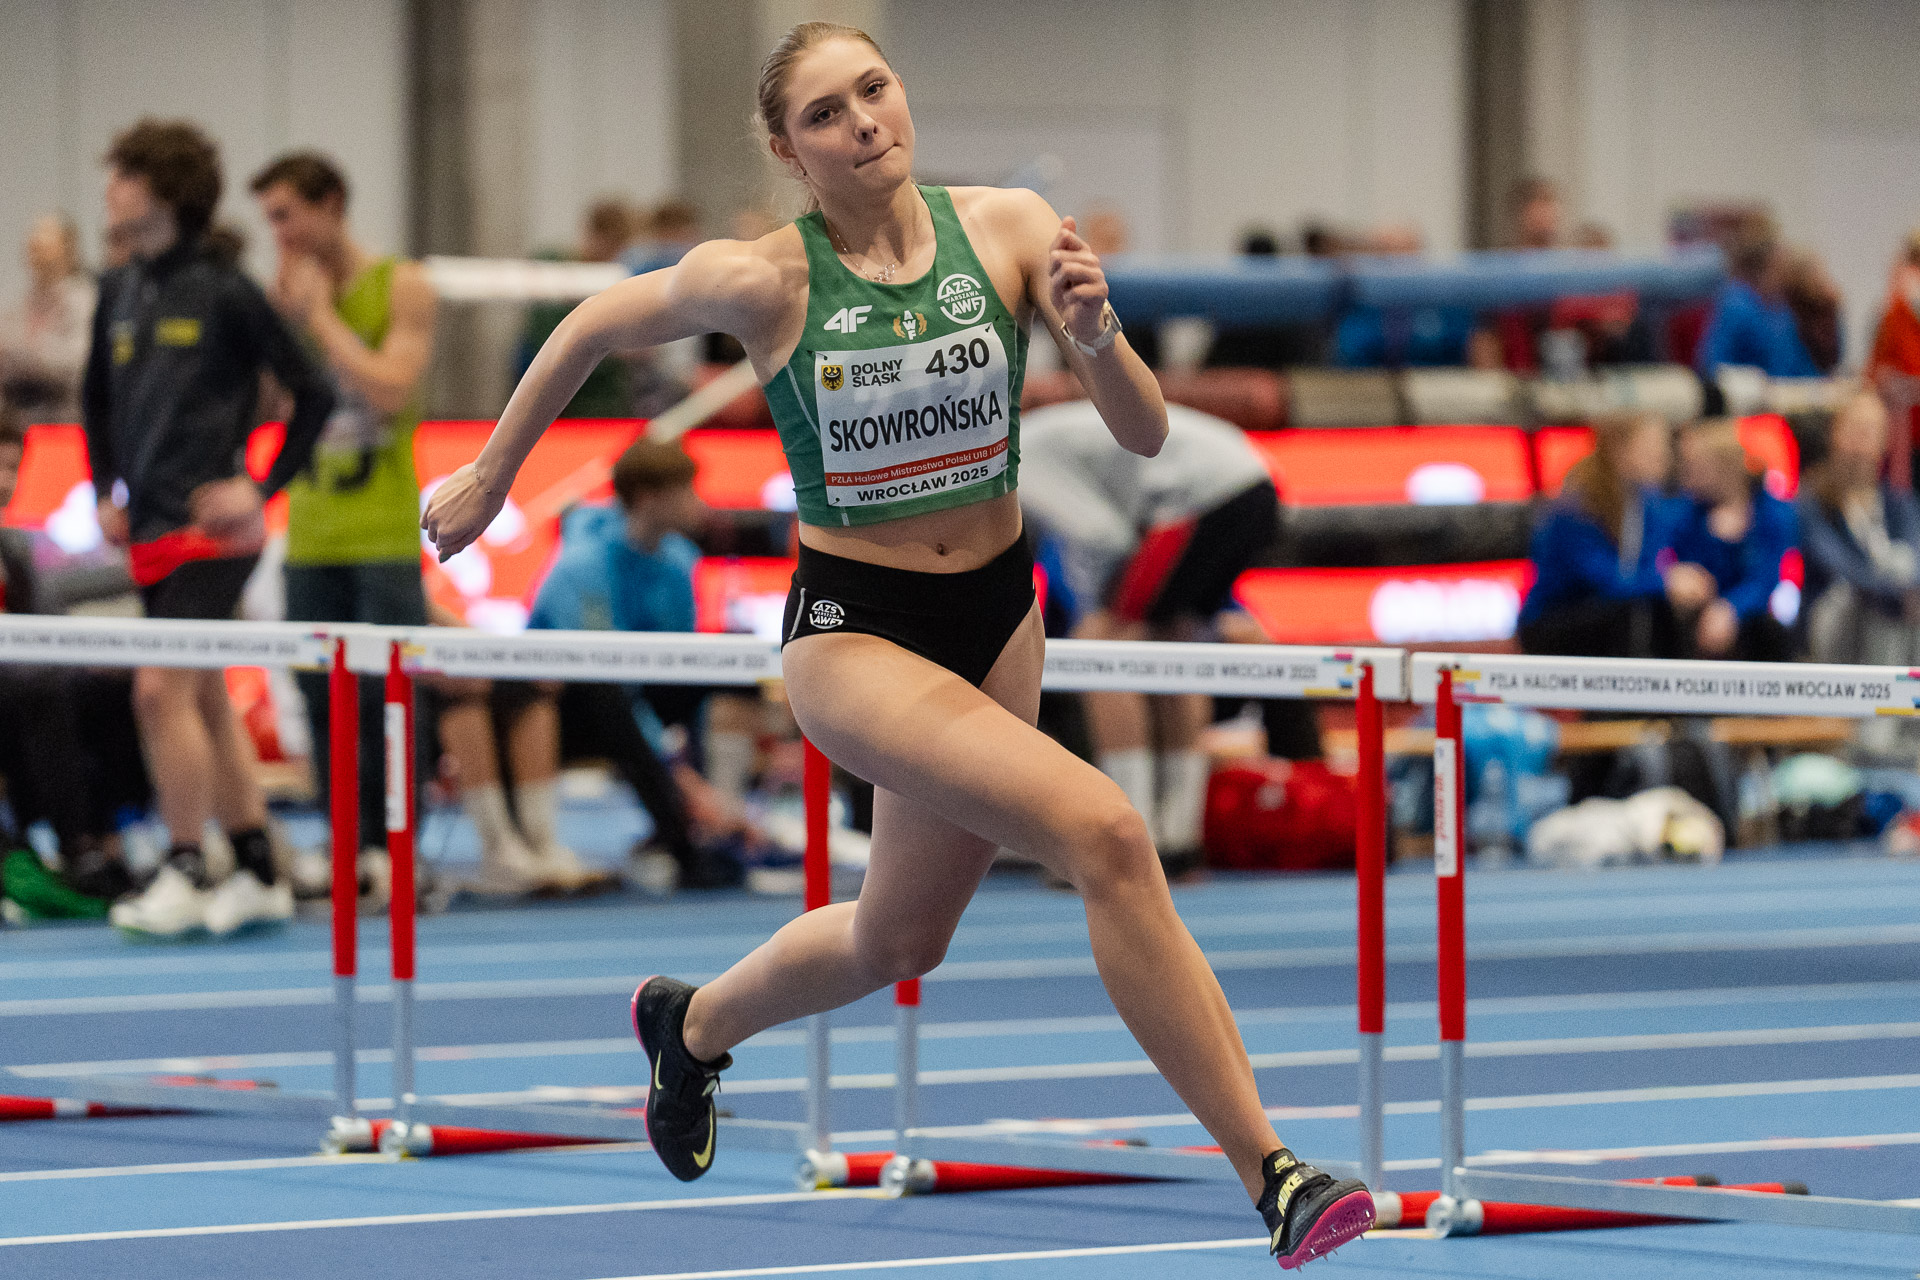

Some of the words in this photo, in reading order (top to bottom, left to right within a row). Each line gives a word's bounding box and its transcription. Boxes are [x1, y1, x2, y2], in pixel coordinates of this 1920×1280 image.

[944, 280, 971, 296] AZS
[944, 290, 980, 303] WARSZAWA
[952, 296, 980, 316] AWF
[824, 305, 873, 334] 4F
[851, 358, 903, 376] DOLNY
[924, 337, 990, 378] 430
[852, 370, 902, 388] ŚLĄSK
[828, 390, 1003, 452] SKOWROŃSKA
[831, 474, 853, 485] PZLA
[854, 471, 889, 483] Halowe
[890, 460, 944, 477] Mistrzostwa
[945, 453, 972, 466] Polski
[973, 448, 988, 460] U18
[857, 475, 948, 502] WROCŁAW
[950, 465, 990, 484] 2025
[817, 603, 837, 614] AZS
[814, 615, 838, 625] AWF
[1490, 671, 1518, 689] PZLA
[1522, 672, 1578, 691] HALOWE
[1582, 674, 1672, 694] MISTRZOSTWA
[1675, 677, 1719, 695] POLSKI
[1722, 679, 1747, 696] U18
[1757, 679, 1781, 698] U20
[1859, 681, 1891, 700] 2025
[1274, 1155, 1290, 1169] NIKE
[1277, 1172, 1304, 1217] NIKE
